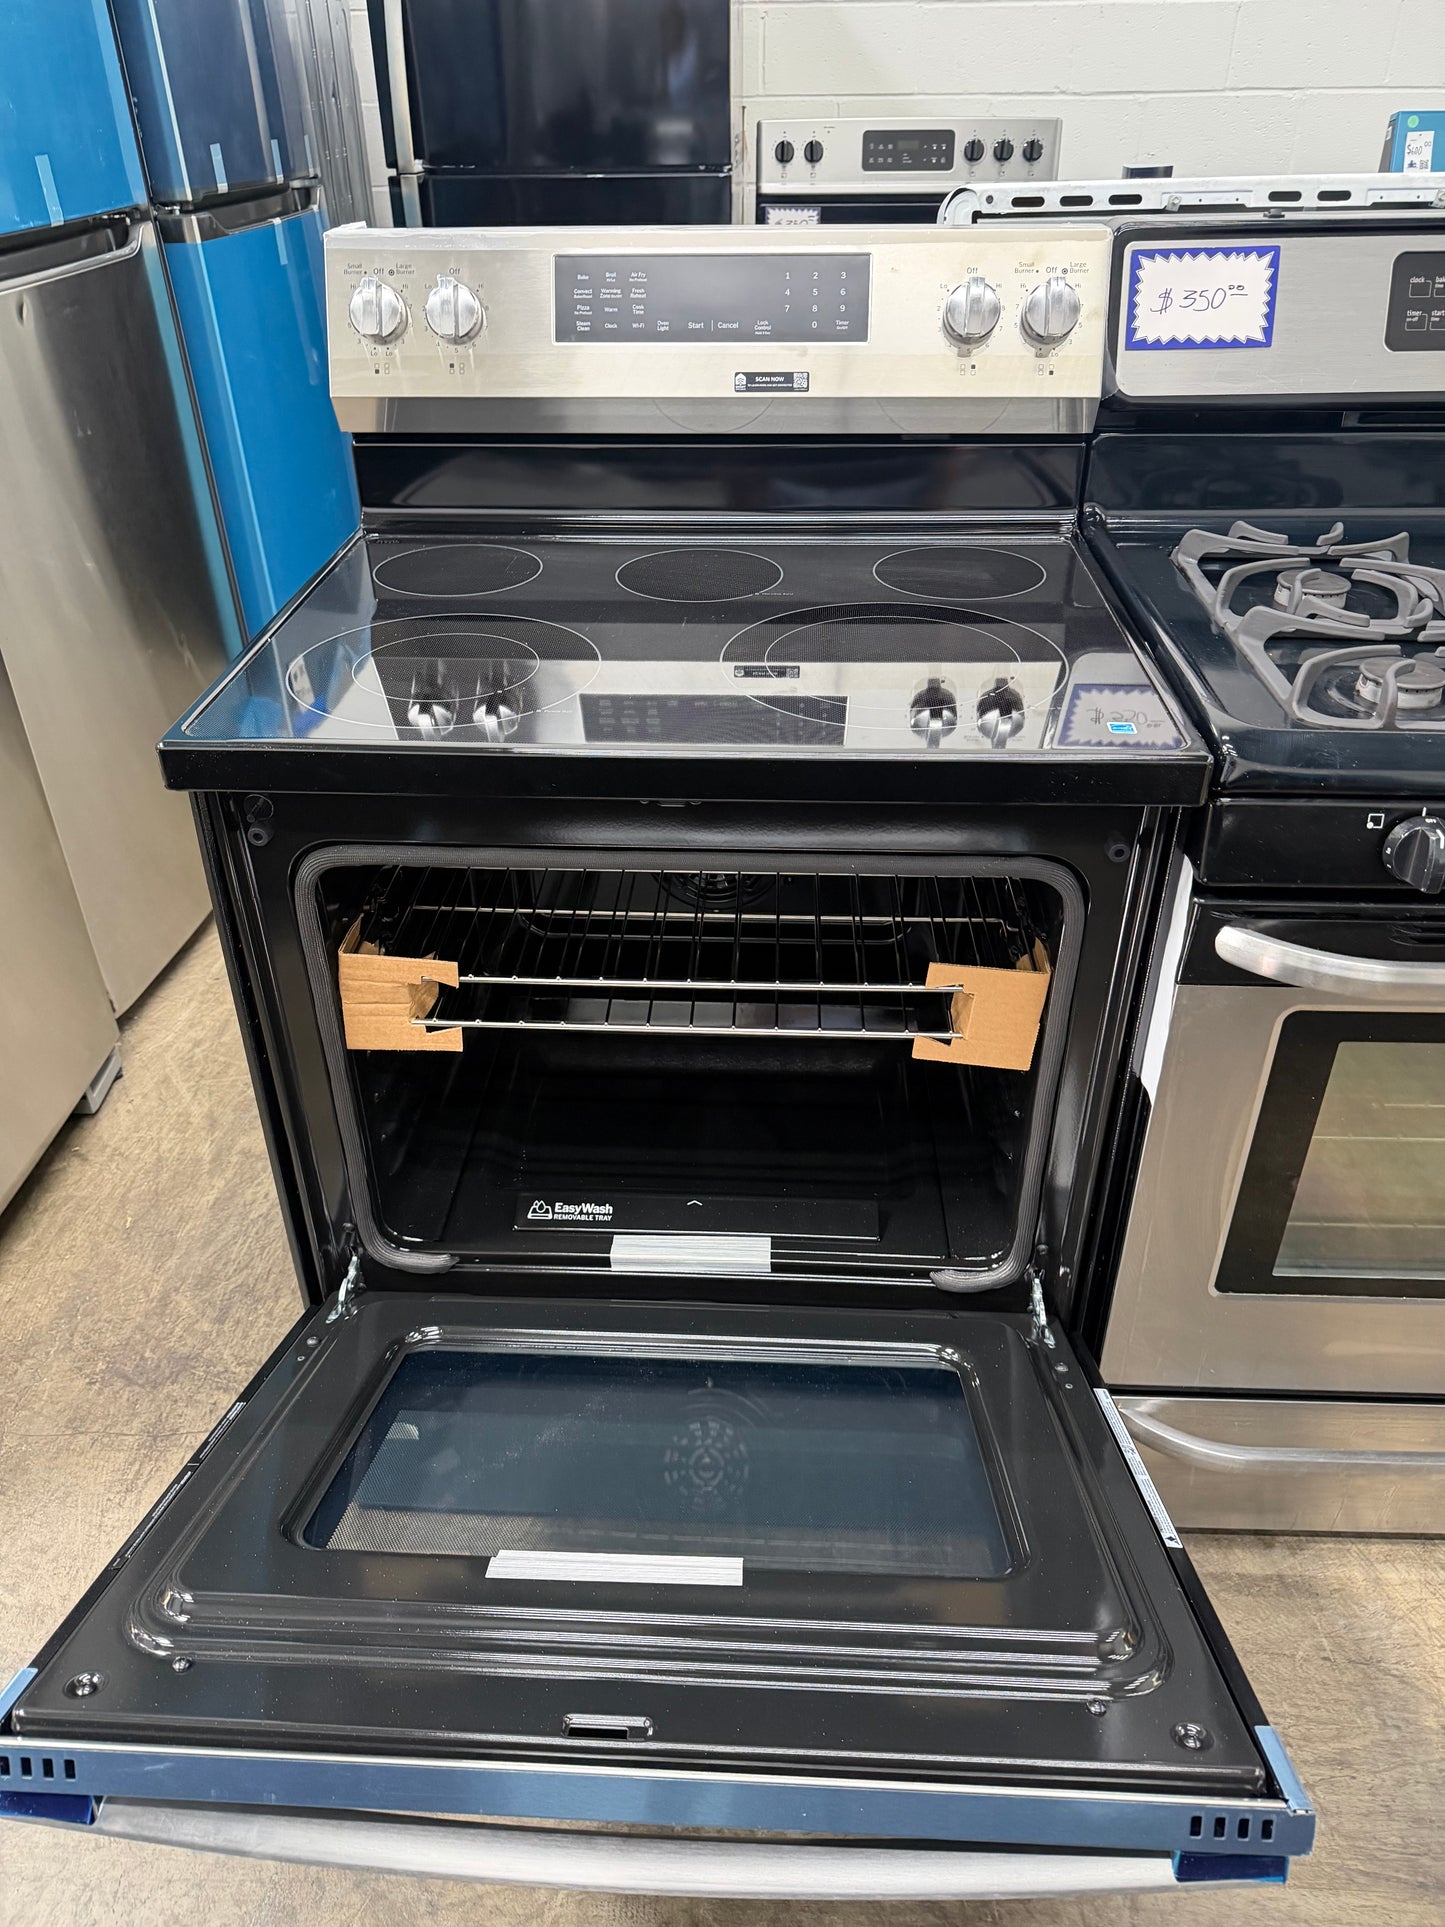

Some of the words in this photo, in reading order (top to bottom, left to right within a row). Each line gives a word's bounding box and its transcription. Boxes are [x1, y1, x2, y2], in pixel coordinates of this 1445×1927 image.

[373, 267, 384, 275] Off
[966, 267, 978, 275] Off
[1045, 266, 1057, 274] Off
[785, 272, 790, 280] 1
[812, 272, 818, 280] 2
[840, 271, 847, 280] 3
[785, 288, 790, 296] 4
[812, 288, 818, 296] 5
[840, 288, 846, 296] 6
[812, 304, 818, 312] 8
[840, 304, 846, 312] 9
[717, 321, 739, 329] Cancel
[811, 321, 818, 329] 0
[554, 1202, 613, 1214] EasyWash
[554, 1213, 594, 1221] REMOVABLE
